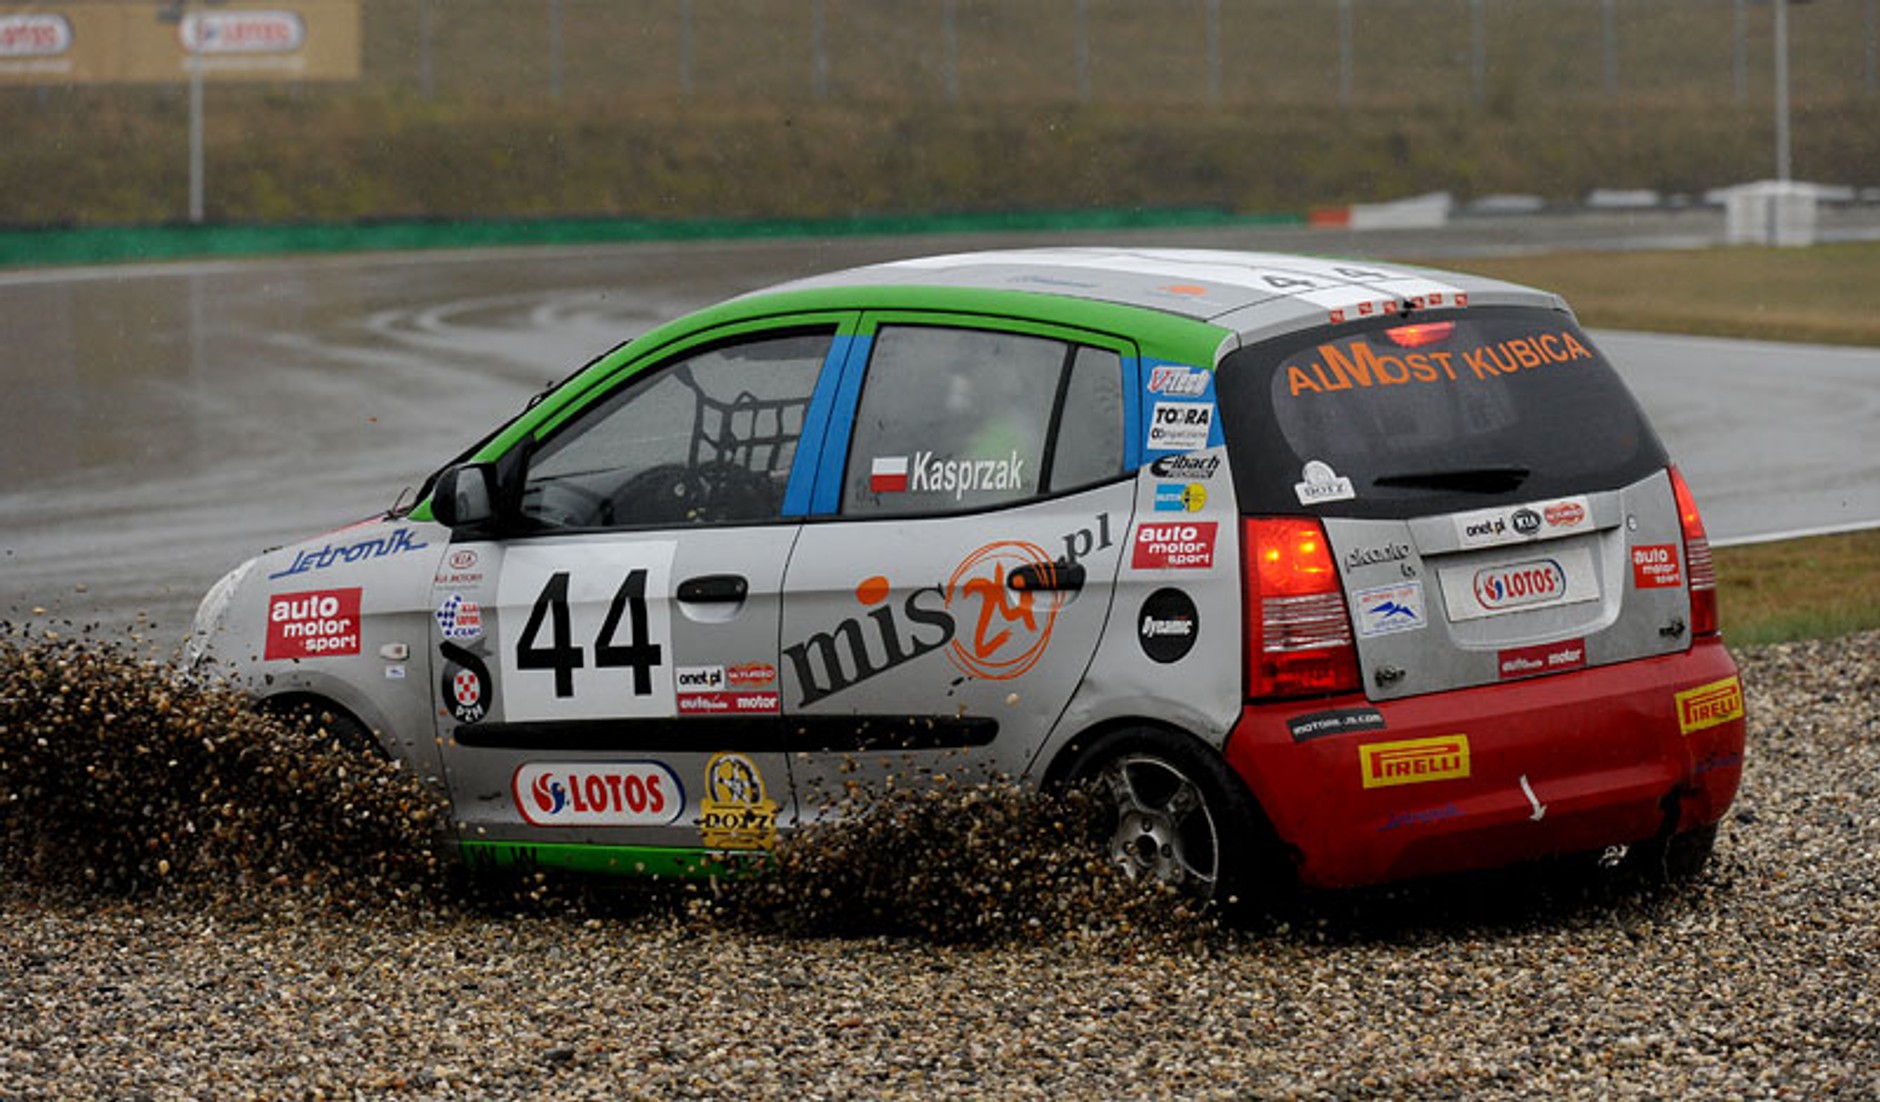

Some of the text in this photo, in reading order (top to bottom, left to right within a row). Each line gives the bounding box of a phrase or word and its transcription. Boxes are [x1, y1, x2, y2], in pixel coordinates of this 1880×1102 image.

[1286, 331, 1593, 397] ALMOST KUBICA
[912, 450, 1024, 501] Kasprzak
[1139, 525, 1197, 542] auto
[1149, 541, 1207, 554] motor
[1168, 553, 1209, 565] sport
[1634, 549, 1669, 565] auto
[1503, 567, 1555, 599] LOTOS
[272, 595, 339, 622] auto
[283, 618, 351, 638] motor
[516, 568, 662, 697] 44
[305, 633, 357, 651] sport
[679, 669, 721, 688] onet.pl
[737, 696, 777, 709] motor
[1682, 684, 1740, 726] PIRELLI
[1371, 742, 1461, 779] PIRELLI
[568, 773, 665, 813] LOTOS
